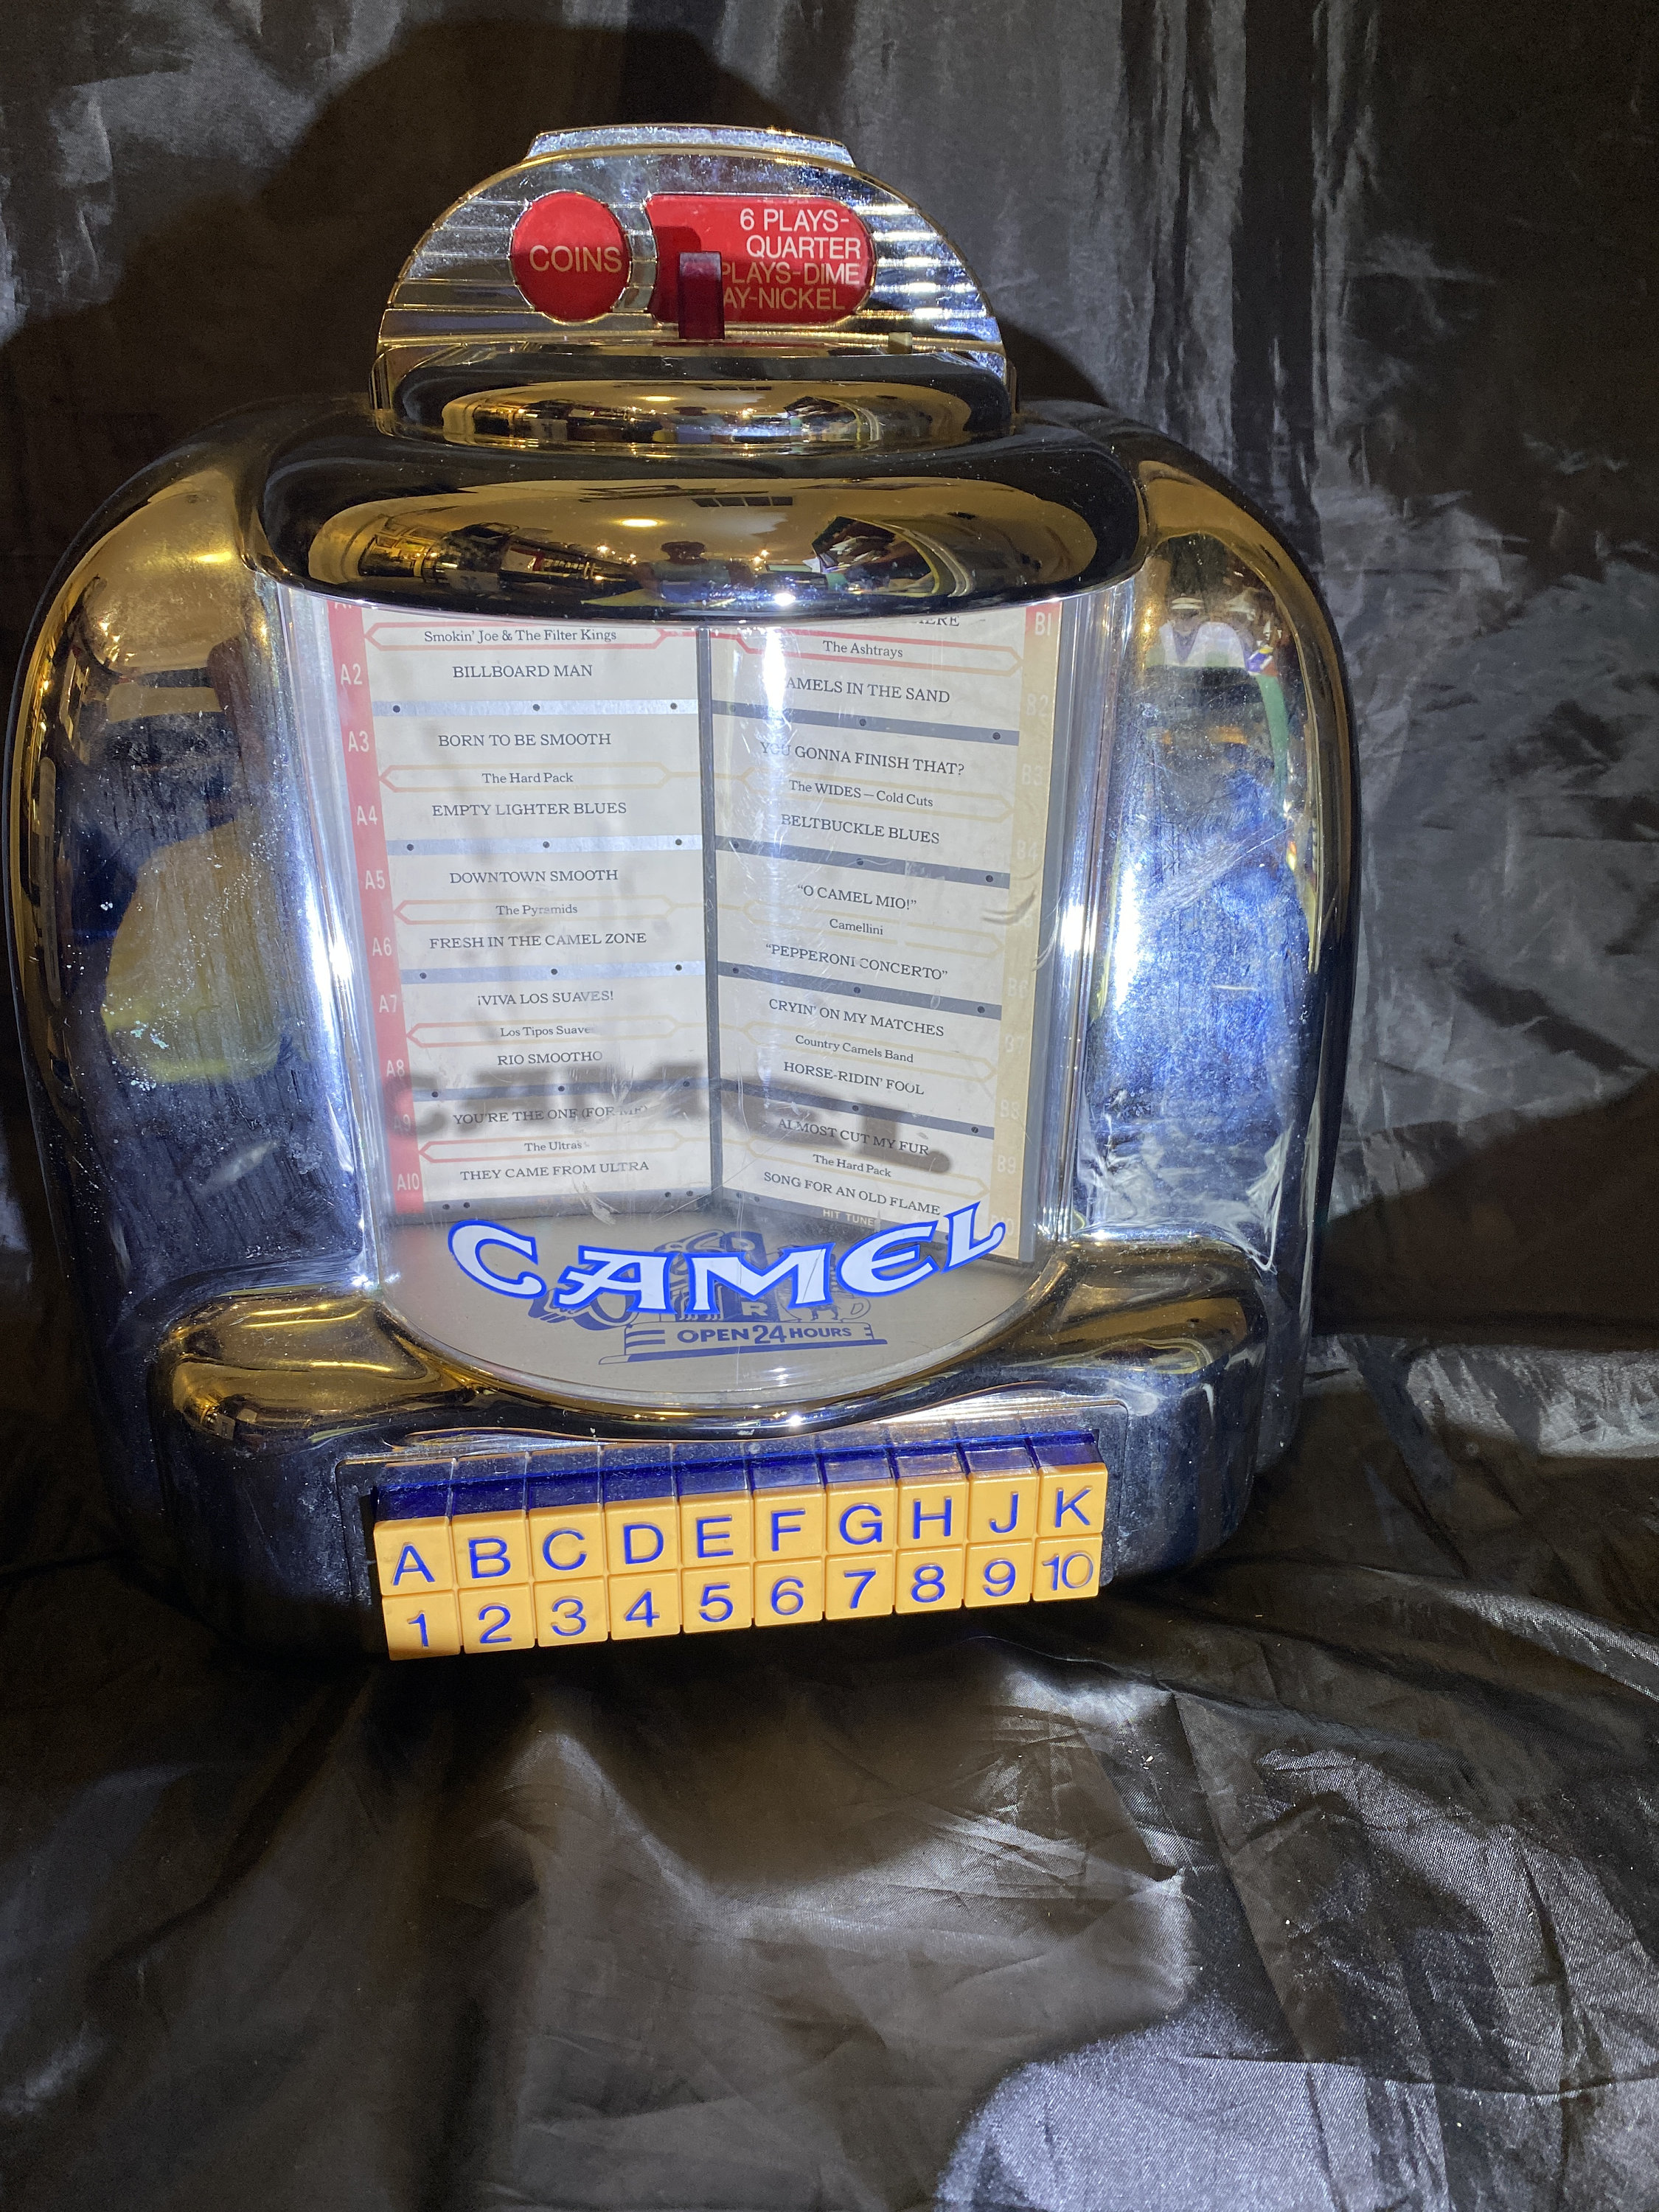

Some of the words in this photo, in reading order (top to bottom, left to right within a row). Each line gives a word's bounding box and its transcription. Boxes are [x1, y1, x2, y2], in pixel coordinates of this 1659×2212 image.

[740, 208, 754, 231] 6
[764, 209, 849, 233] PLAYS-
[746, 234, 861, 260] QUARTER
[529, 244, 622, 273] COINS
[478, 630, 498, 643] Joe
[501, 630, 512, 641] &
[515, 630, 541, 641] The
[544, 629, 577, 641] Filter
[580, 629, 616, 643] Kings
[823, 640, 848, 655] The
[850, 643, 903, 658] Ashtrays
[341, 664, 363, 685] A2
[452, 665, 549, 678] BILLBOARD
[554, 664, 592, 678] MAN
[786, 677, 843, 694] AMELS
[846, 682, 863, 695] IN
[867, 684, 902, 699] THE
[905, 687, 950, 703] SAND
[1026, 693, 1048, 717] B2
[348, 731, 369, 753] A3
[438, 735, 484, 747] BORN
[489, 735, 510, 746] TO
[515, 734, 535, 746] BE
[540, 733, 611, 746] SMOOTH
[795, 746, 851, 764] GONNA
[855, 752, 910, 770] FINISH
[912, 758, 965, 776] THAT?
[482, 773, 507, 784] The
[509, 772, 541, 783] Hard
[546, 771, 573, 782] Pack
[789, 779, 813, 793] The
[815, 782, 861, 799] WIDES
[876, 790, 903, 804] Cold
[908, 793, 933, 807] Cuts
[356, 805, 378, 826] A4
[432, 804, 491, 817] EMPTY
[495, 803, 570, 815] LIGHTER
[574, 802, 627, 814] BLUES
[781, 814, 886, 838] BELTBUCKLE
[888, 827, 940, 844] BLUES
[364, 870, 386, 889] A5
[450, 872, 546, 884] DOWNTOWN
[550, 869, 619, 883] SMOOTH
[817, 886, 873, 905] CAMEL
[495, 905, 519, 914] The
[523, 904, 578, 917] Pyramids
[830, 918, 884, 936] Camellini
[372, 937, 392, 956] A6
[429, 937, 484, 949] FRESH
[488, 936, 505, 947] IN
[508, 936, 541, 947] THE
[545, 933, 602, 946] CAMEL
[605, 933, 647, 945] ZONE
[379, 995, 397, 1013] A7
[520, 993, 548, 1004] LOS
[551, 990, 613, 1004] SUAVES!
[819, 1006, 840, 1021] ON
[844, 1009, 868, 1025] MY
[870, 1014, 945, 1038] MATCHES
[500, 1027, 523, 1037] Los
[525, 1026, 553, 1038] Tipos
[498, 1053, 524, 1065] RIO
[527, 1051, 602, 1064] SMOOTHO
[795, 1034, 840, 1052] Country
[842, 1042, 883, 1059] Camels
[885, 1048, 914, 1064] Band
[386, 1060, 405, 1077] A8
[886, 1078, 925, 1096] FOOL
[392, 1113, 411, 1134] A9
[512, 1110, 543, 1121] THE
[546, 1107, 577, 1120] ONE
[582, 1107, 616, 1120] (FOR
[778, 1117, 838, 1139] ALMOST
[840, 1128, 871, 1144] CUT
[872, 1134, 897, 1150] MY
[899, 1139, 930, 1156] FUR
[524, 1141, 546, 1152] The
[461, 1169, 501, 1180] THEY
[505, 1166, 549, 1178] CAME
[553, 1164, 597, 1176] FROM
[599, 1162, 649, 1174] ULTRA
[813, 1152, 835, 1167] The
[837, 1157, 864, 1172] Hard
[866, 1162, 891, 1178] Pack
[998, 1155, 1016, 1175] B9
[397, 1173, 420, 1191] A10
[763, 1170, 801, 1189] SONG
[804, 1178, 833, 1193] FOR
[835, 1184, 856, 1199] AN
[859, 1189, 887, 1206] OLD
[888, 1194, 941, 1216] FLAME
[822, 1208, 840, 1220] HIT
[845, 1211, 880, 1228] TUNE
[448, 1201, 1006, 1315] CAMEL
[677, 1328, 749, 1343] OPEN
[752, 1325, 787, 1345] 24
[790, 1326, 852, 1339] HOURS
[392, 1544, 437, 1587] A
[469, 1537, 512, 1579] B
[541, 1528, 587, 1571] C
[622, 1523, 665, 1565] D
[696, 1516, 734, 1559] E
[771, 1508, 806, 1553] F
[838, 1503, 883, 1545] G
[914, 1497, 953, 1540] H
[989, 1492, 1018, 1534] J
[1055, 1486, 1091, 1528] K
[406, 1613, 430, 1649] 1
[477, 1605, 512, 1644] 2
[551, 1599, 588, 1636] 3
[625, 1590, 661, 1628] 4
[699, 1583, 734, 1623] 5
[771, 1578, 804, 1616] 6
[844, 1568, 877, 1610] 7
[911, 1564, 945, 1604] 8
[981, 1558, 1016, 1597] 9
[1041, 1550, 1093, 1589] 10
